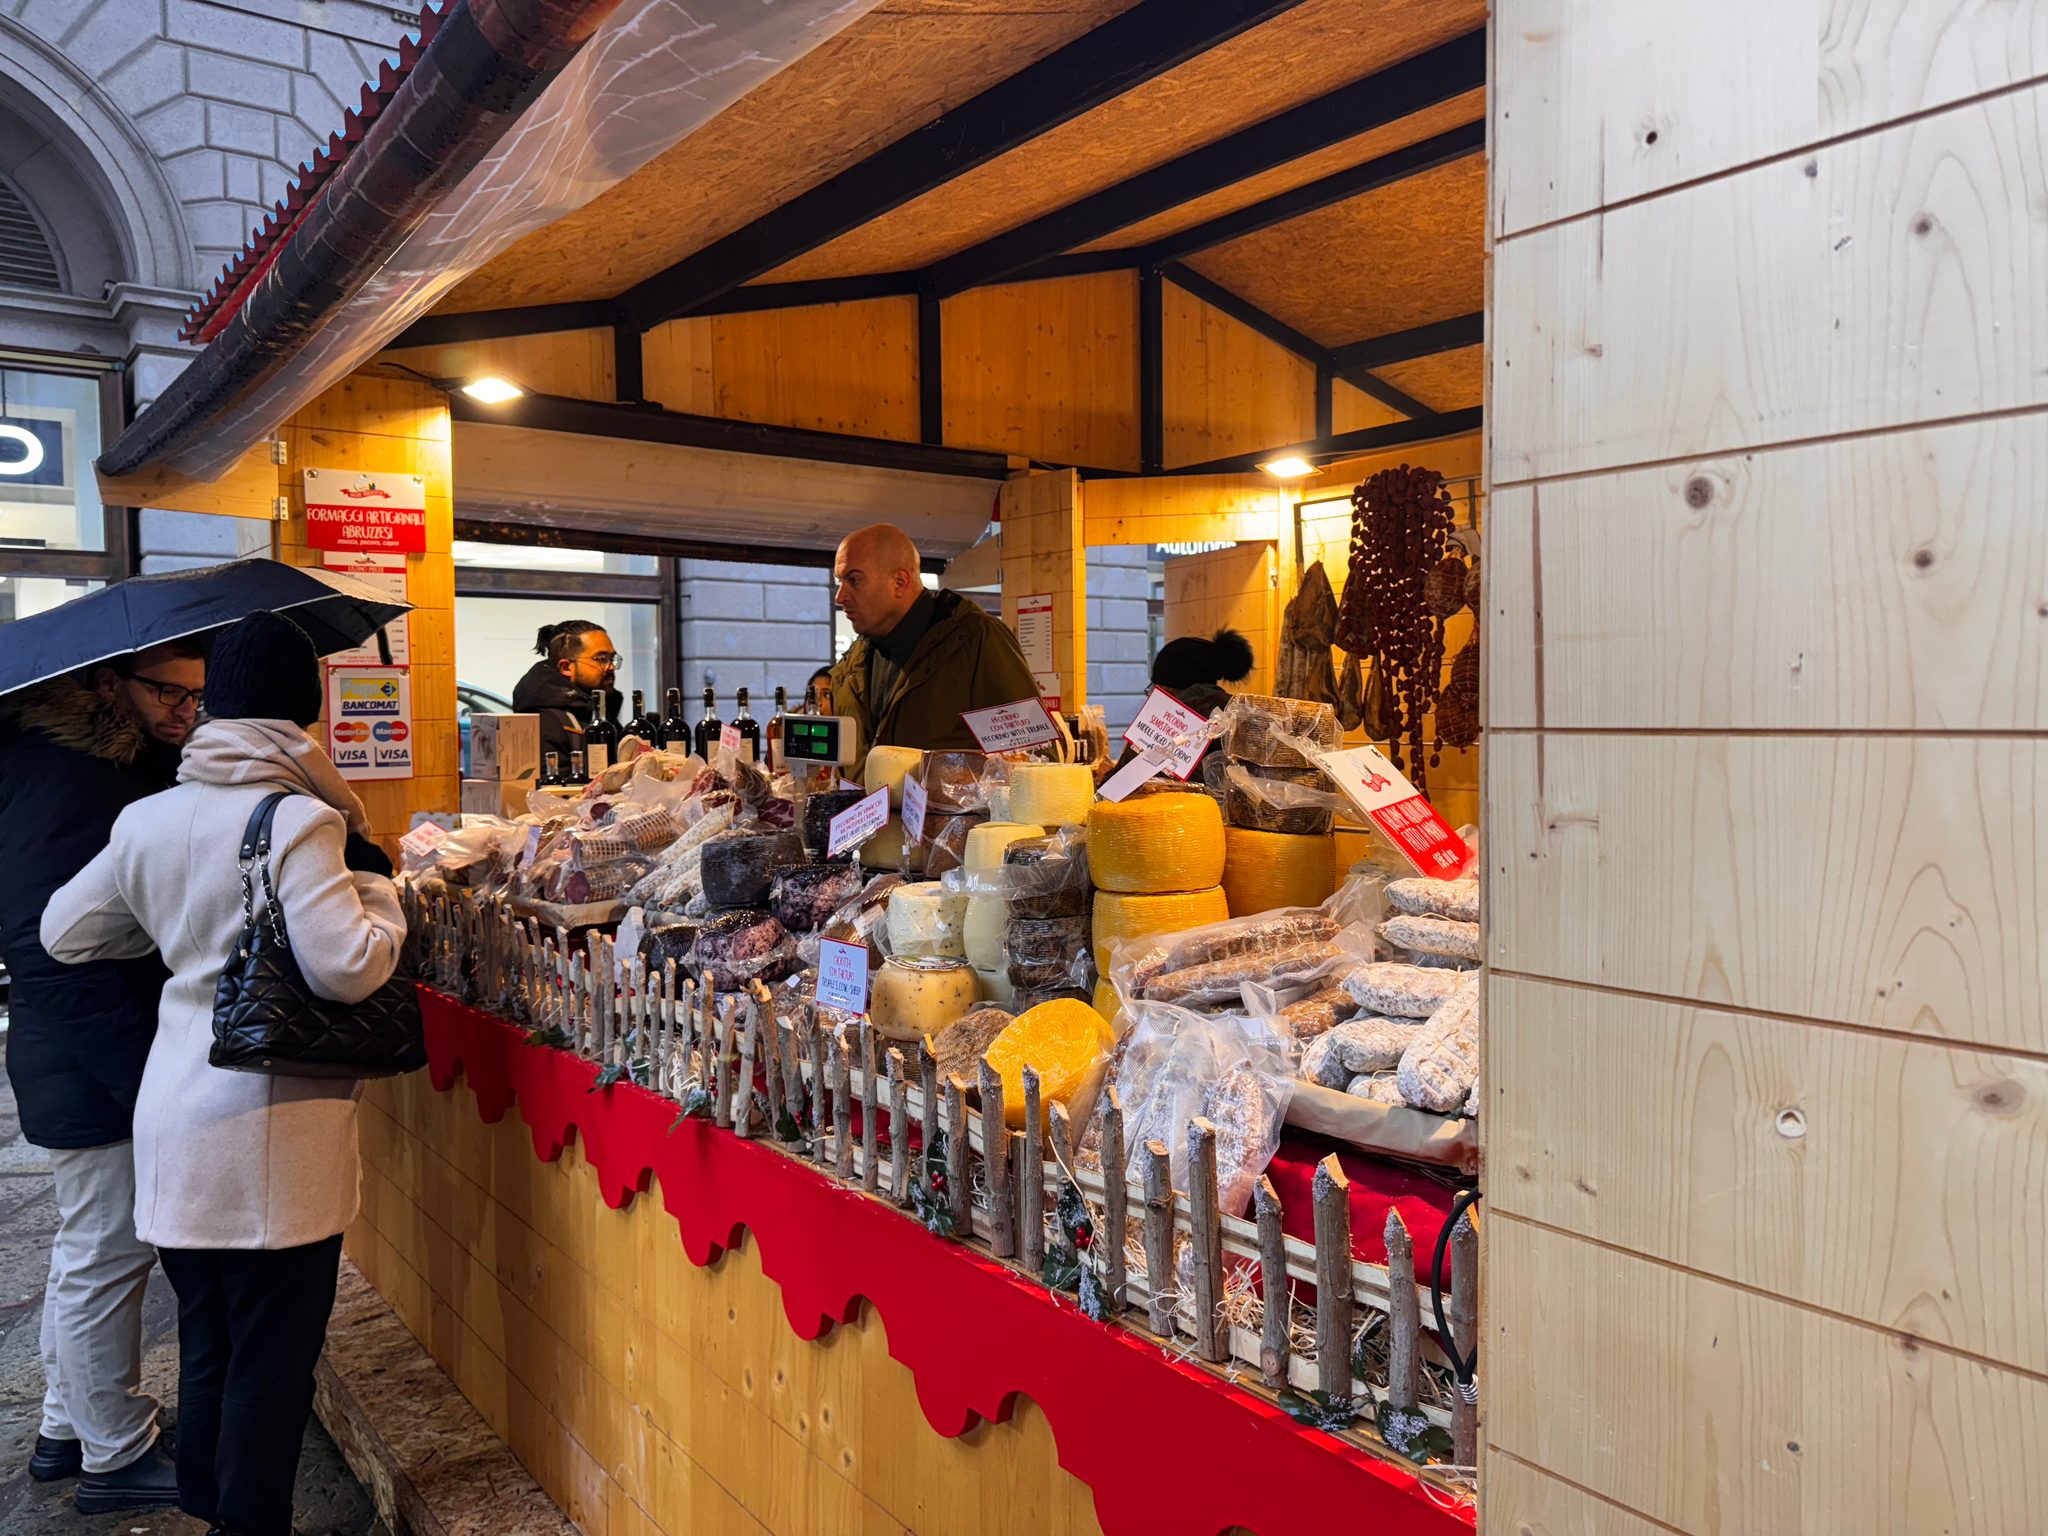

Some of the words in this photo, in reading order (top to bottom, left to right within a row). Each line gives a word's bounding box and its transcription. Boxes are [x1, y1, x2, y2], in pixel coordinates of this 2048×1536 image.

[307, 508, 363, 523] FORMAGGI
[365, 510, 425, 526] ARTIGIANALI
[342, 525, 393, 540] ABRUZZESI
[343, 700, 398, 710] BANCOMAT
[990, 712, 1020, 724] PECORINO
[1162, 711, 1189, 733] PECORINO
[990, 724, 1004, 732] CON
[1136, 720, 1155, 738] MIDDLE
[1153, 732, 1168, 746] AGED
[981, 731, 1010, 744] PECORINO
[1009, 728, 1027, 737] WITH
[338, 750, 368, 760] VISA
[379, 749, 409, 759] VISA
[1400, 827, 1431, 854] FATTO
